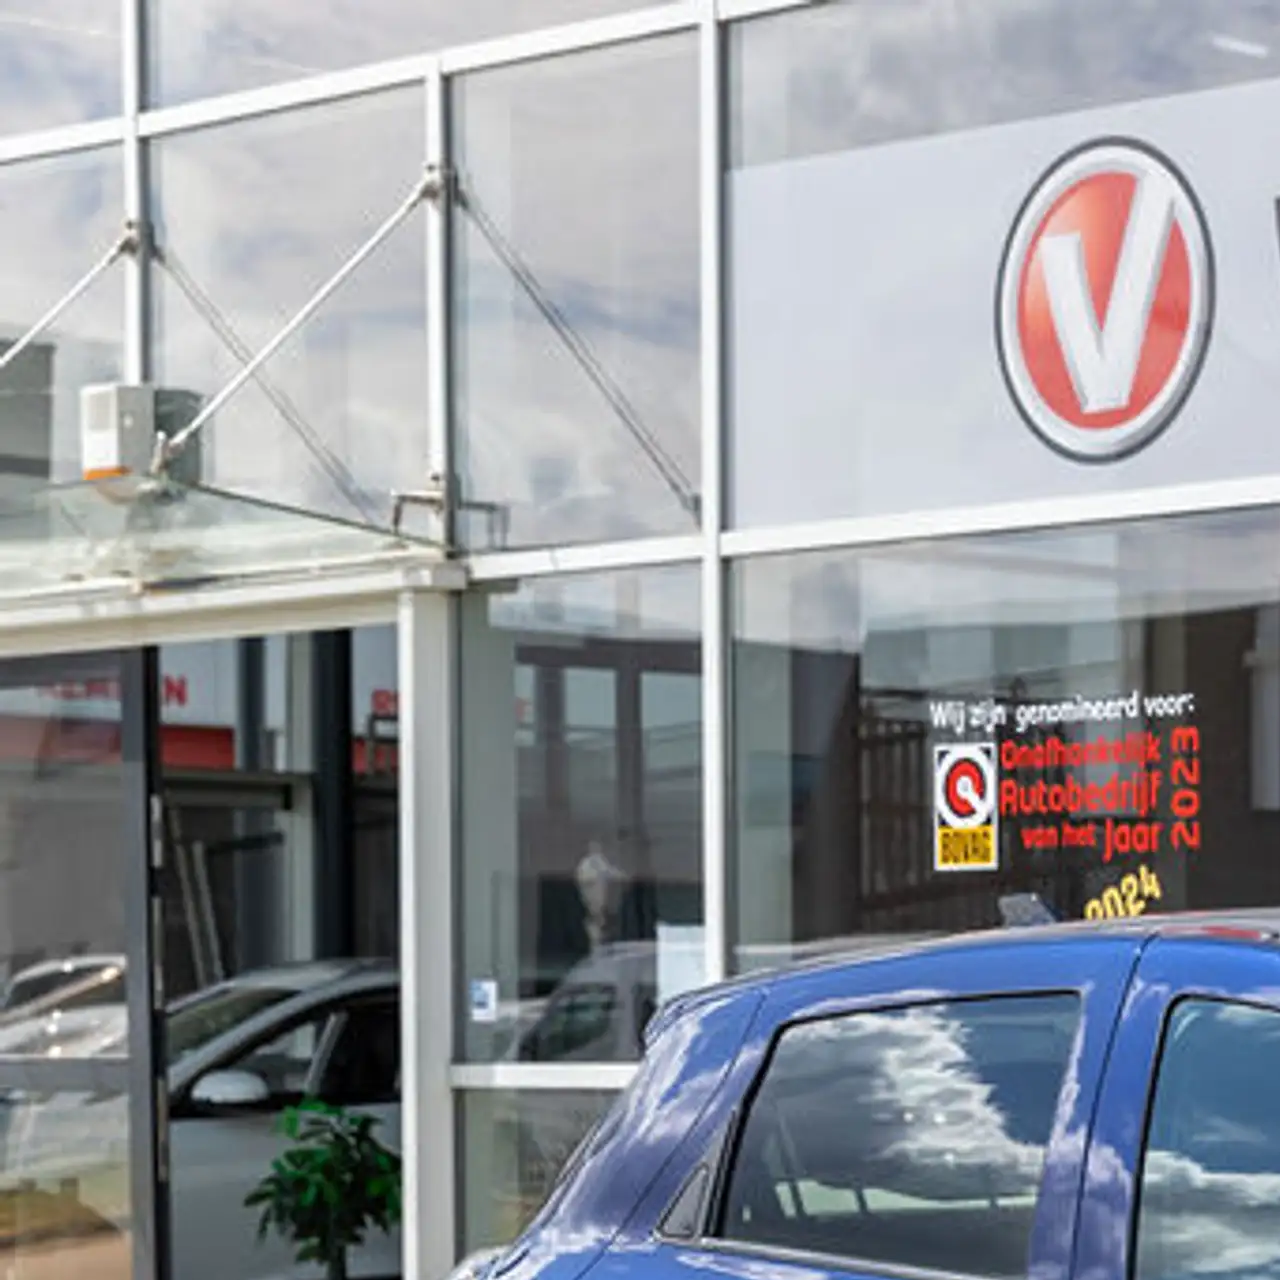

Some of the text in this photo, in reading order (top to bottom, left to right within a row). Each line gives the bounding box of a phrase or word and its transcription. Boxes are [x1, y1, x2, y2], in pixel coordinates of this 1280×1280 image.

[930, 700, 965, 735] Wij
[968, 698, 1007, 734] zijn
[1143, 693, 1195, 716] voor:
[1000, 770, 1163, 817] Autobedrijf
[1170, 725, 1199, 851] 2023
